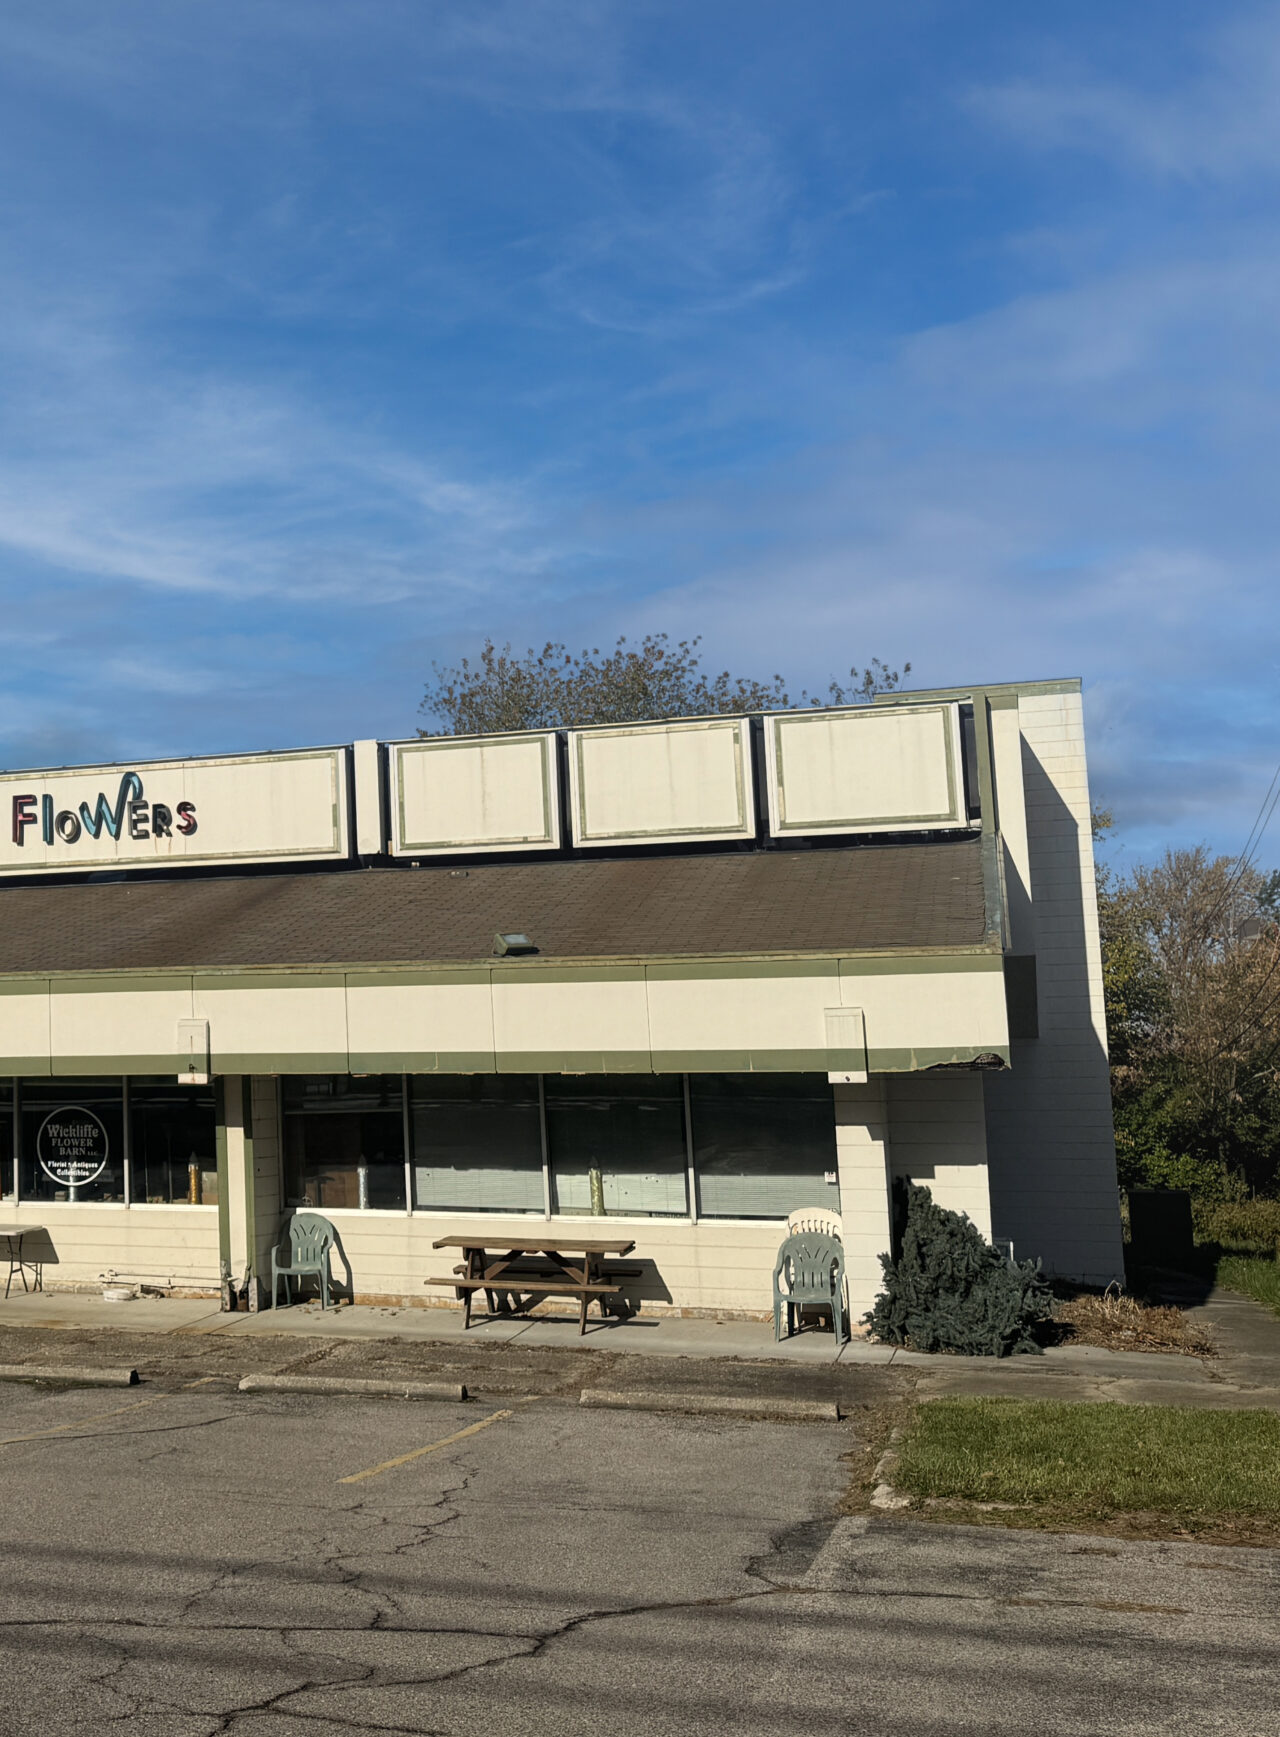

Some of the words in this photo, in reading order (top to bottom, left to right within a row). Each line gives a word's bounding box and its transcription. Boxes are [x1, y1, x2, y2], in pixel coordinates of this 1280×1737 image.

[46, 1124, 99, 1138] Wickliffe
[51, 1138, 93, 1147] FLOWER
[59, 1147, 86, 1156] BARN
[47, 1160, 67, 1168] Florist
[71, 1160, 99, 1169] Antiques
